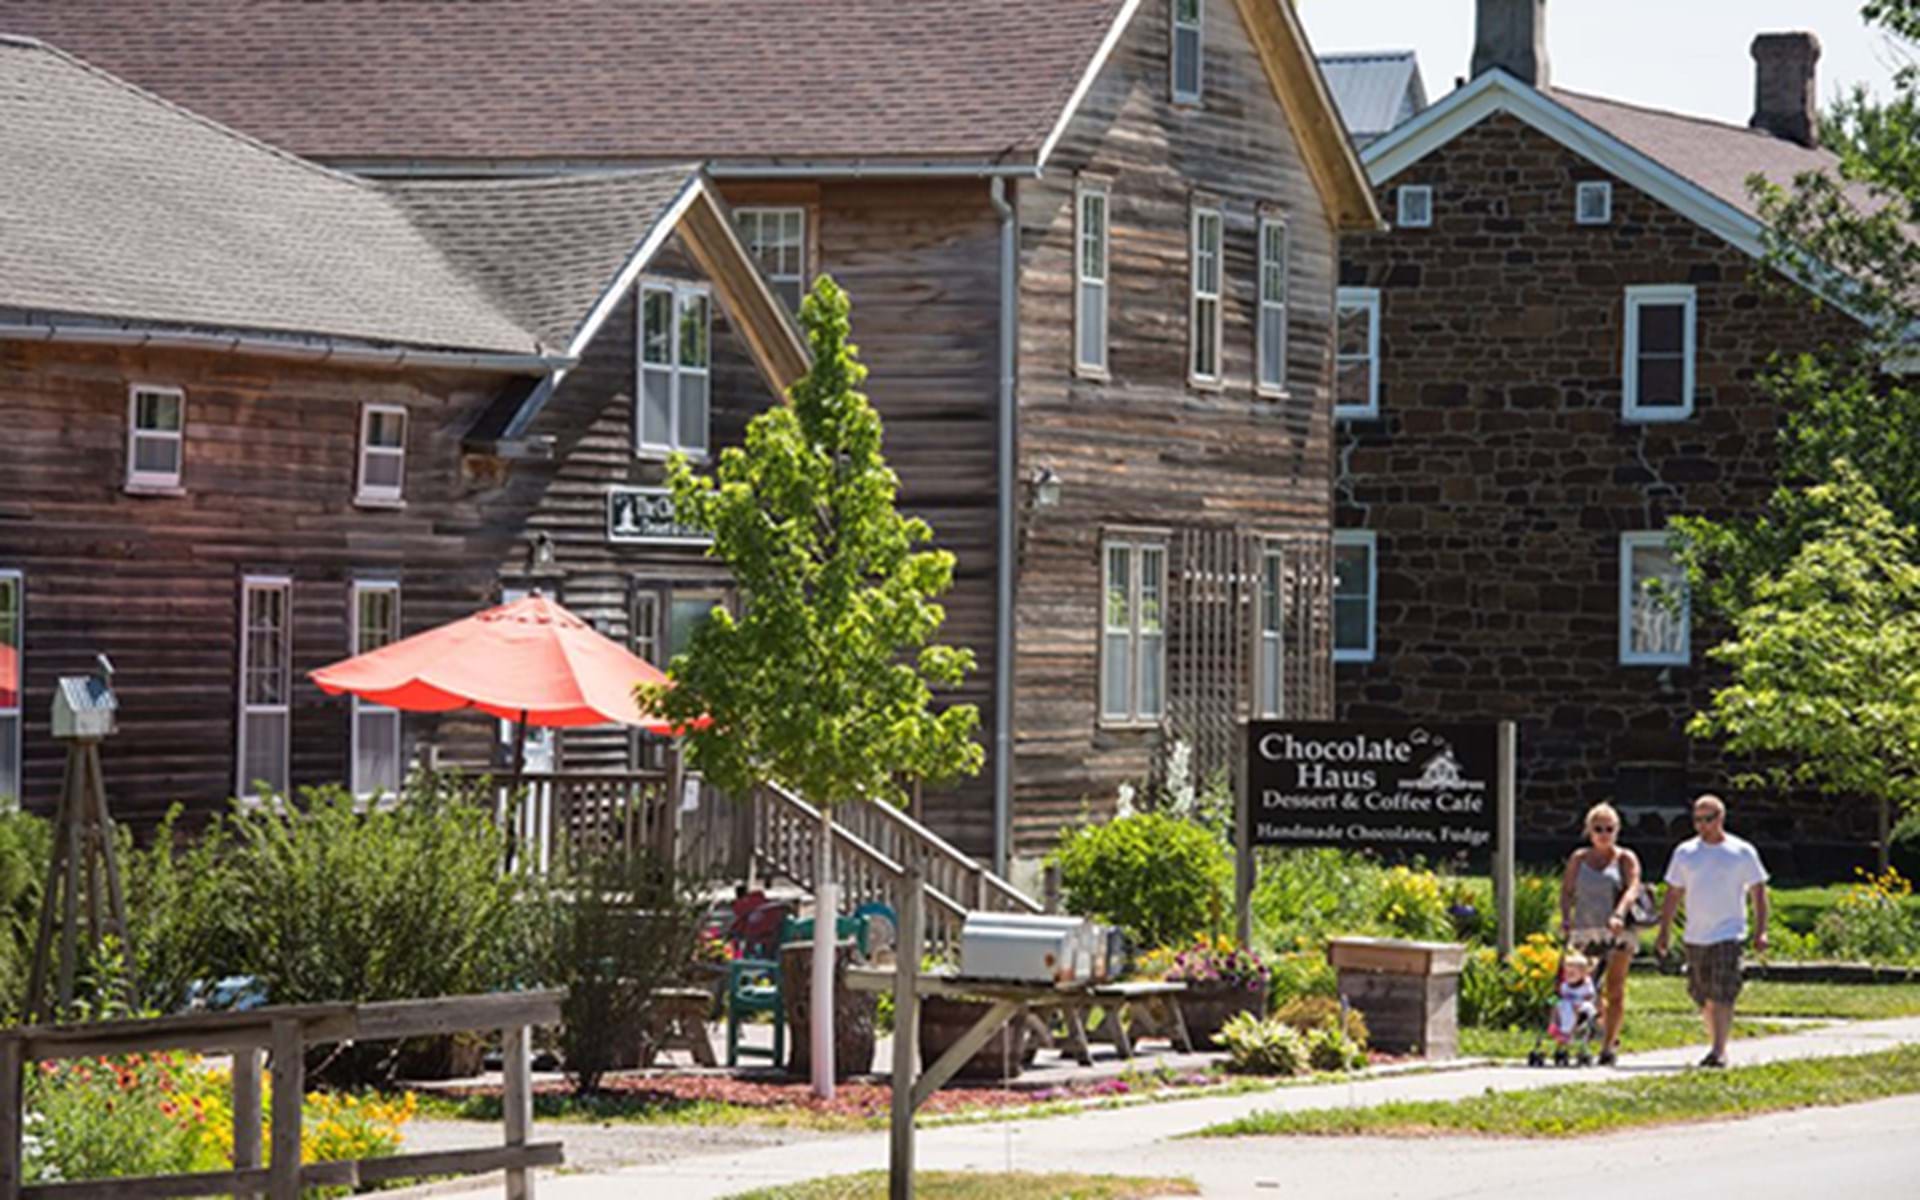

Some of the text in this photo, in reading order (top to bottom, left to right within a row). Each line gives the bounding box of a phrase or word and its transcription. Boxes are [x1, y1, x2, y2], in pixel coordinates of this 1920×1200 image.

[1259, 733, 1412, 762] Chocolate
[1297, 763, 1377, 790] Haus
[1262, 790, 1337, 810] Dessert
[1341, 792, 1360, 810] &
[1364, 791, 1432, 811] Coffee
[1257, 823, 1489, 846] Handmade Chocolates, Fudge
